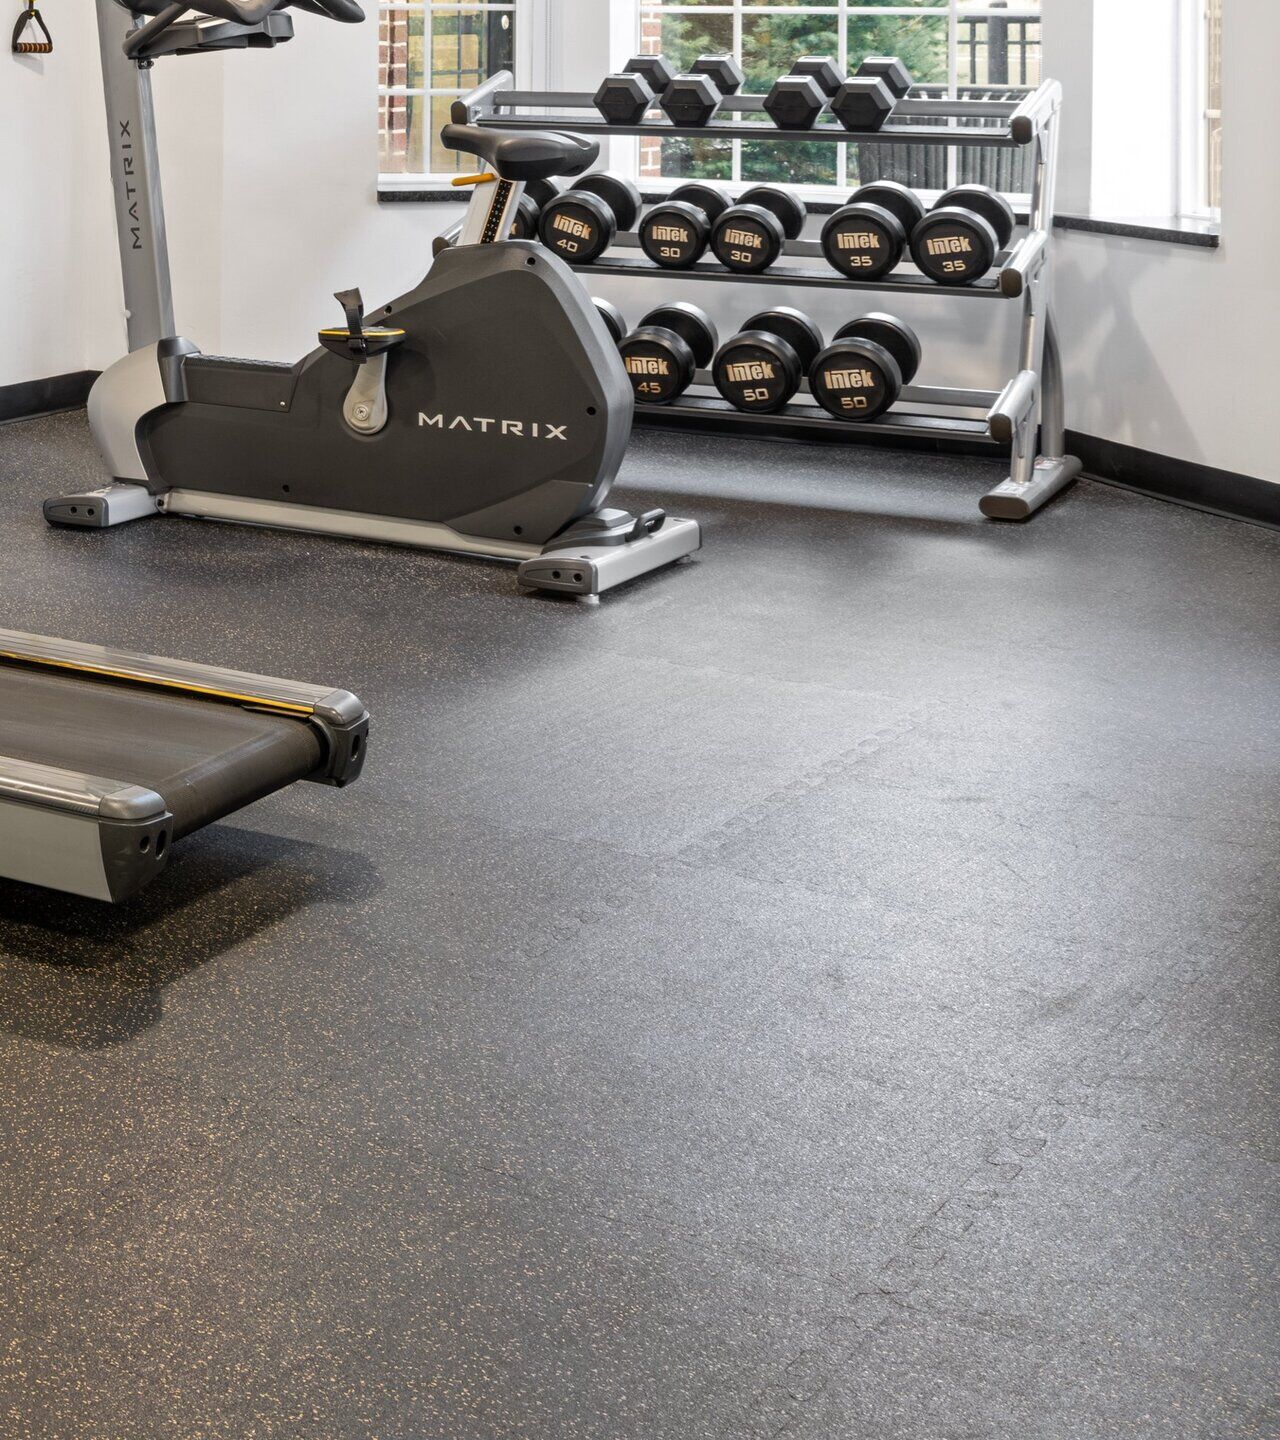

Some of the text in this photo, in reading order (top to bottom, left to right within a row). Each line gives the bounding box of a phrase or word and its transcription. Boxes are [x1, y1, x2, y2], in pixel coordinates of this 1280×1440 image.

[119, 120, 143, 250] MATRIX
[556, 238, 578, 253] 40
[660, 247, 681, 258] 30
[730, 250, 752, 263] 30
[850, 256, 873, 267] 35
[942, 260, 967, 273] 35
[637, 382, 661, 394] 45
[743, 388, 770, 402] 50
[841, 396, 867, 409] 50
[418, 411, 568, 441] MATRIX
